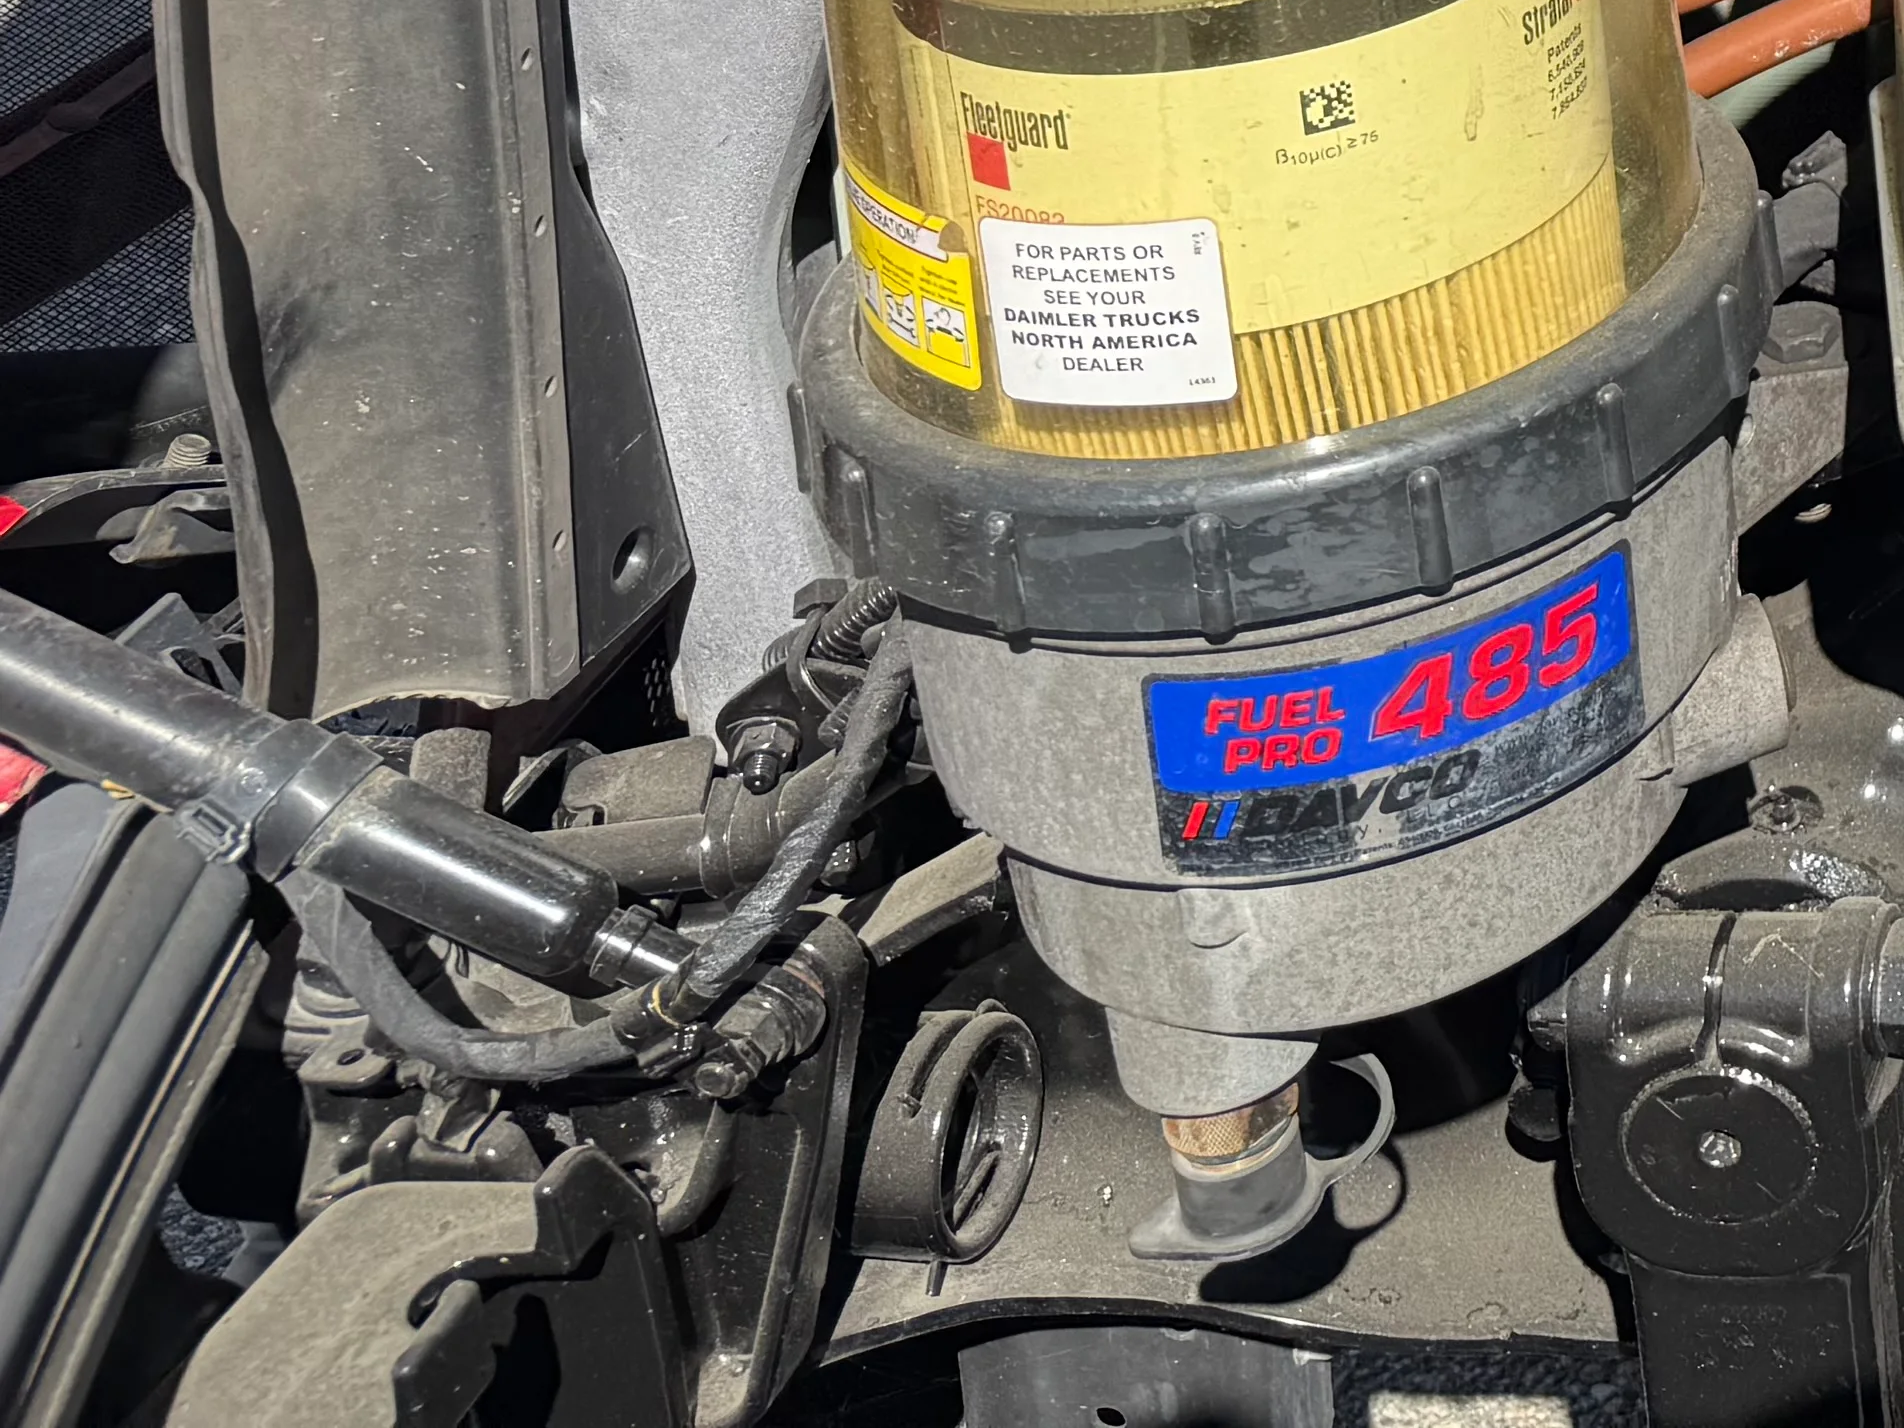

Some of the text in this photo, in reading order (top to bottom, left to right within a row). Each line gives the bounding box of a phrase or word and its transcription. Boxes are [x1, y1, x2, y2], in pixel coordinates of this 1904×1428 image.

[961, 90, 1069, 153] Fleetguard
[1015, 243, 1164, 261] FOR PARTS OR
[1012, 265, 1175, 283] REPLACEMENTS
[1043, 289, 1146, 305] SEE YOUR
[1004, 307, 1200, 328] DAIMLER TRUCKS
[1011, 330, 1197, 350] NORTH AMERICA
[1062, 356, 1144, 372] DEALER
[1369, 582, 1599, 743] 485
[1203, 686, 1346, 736] FUEL
[1222, 727, 1344, 775] PRO
[1241, 748, 1482, 838] DAVCO
